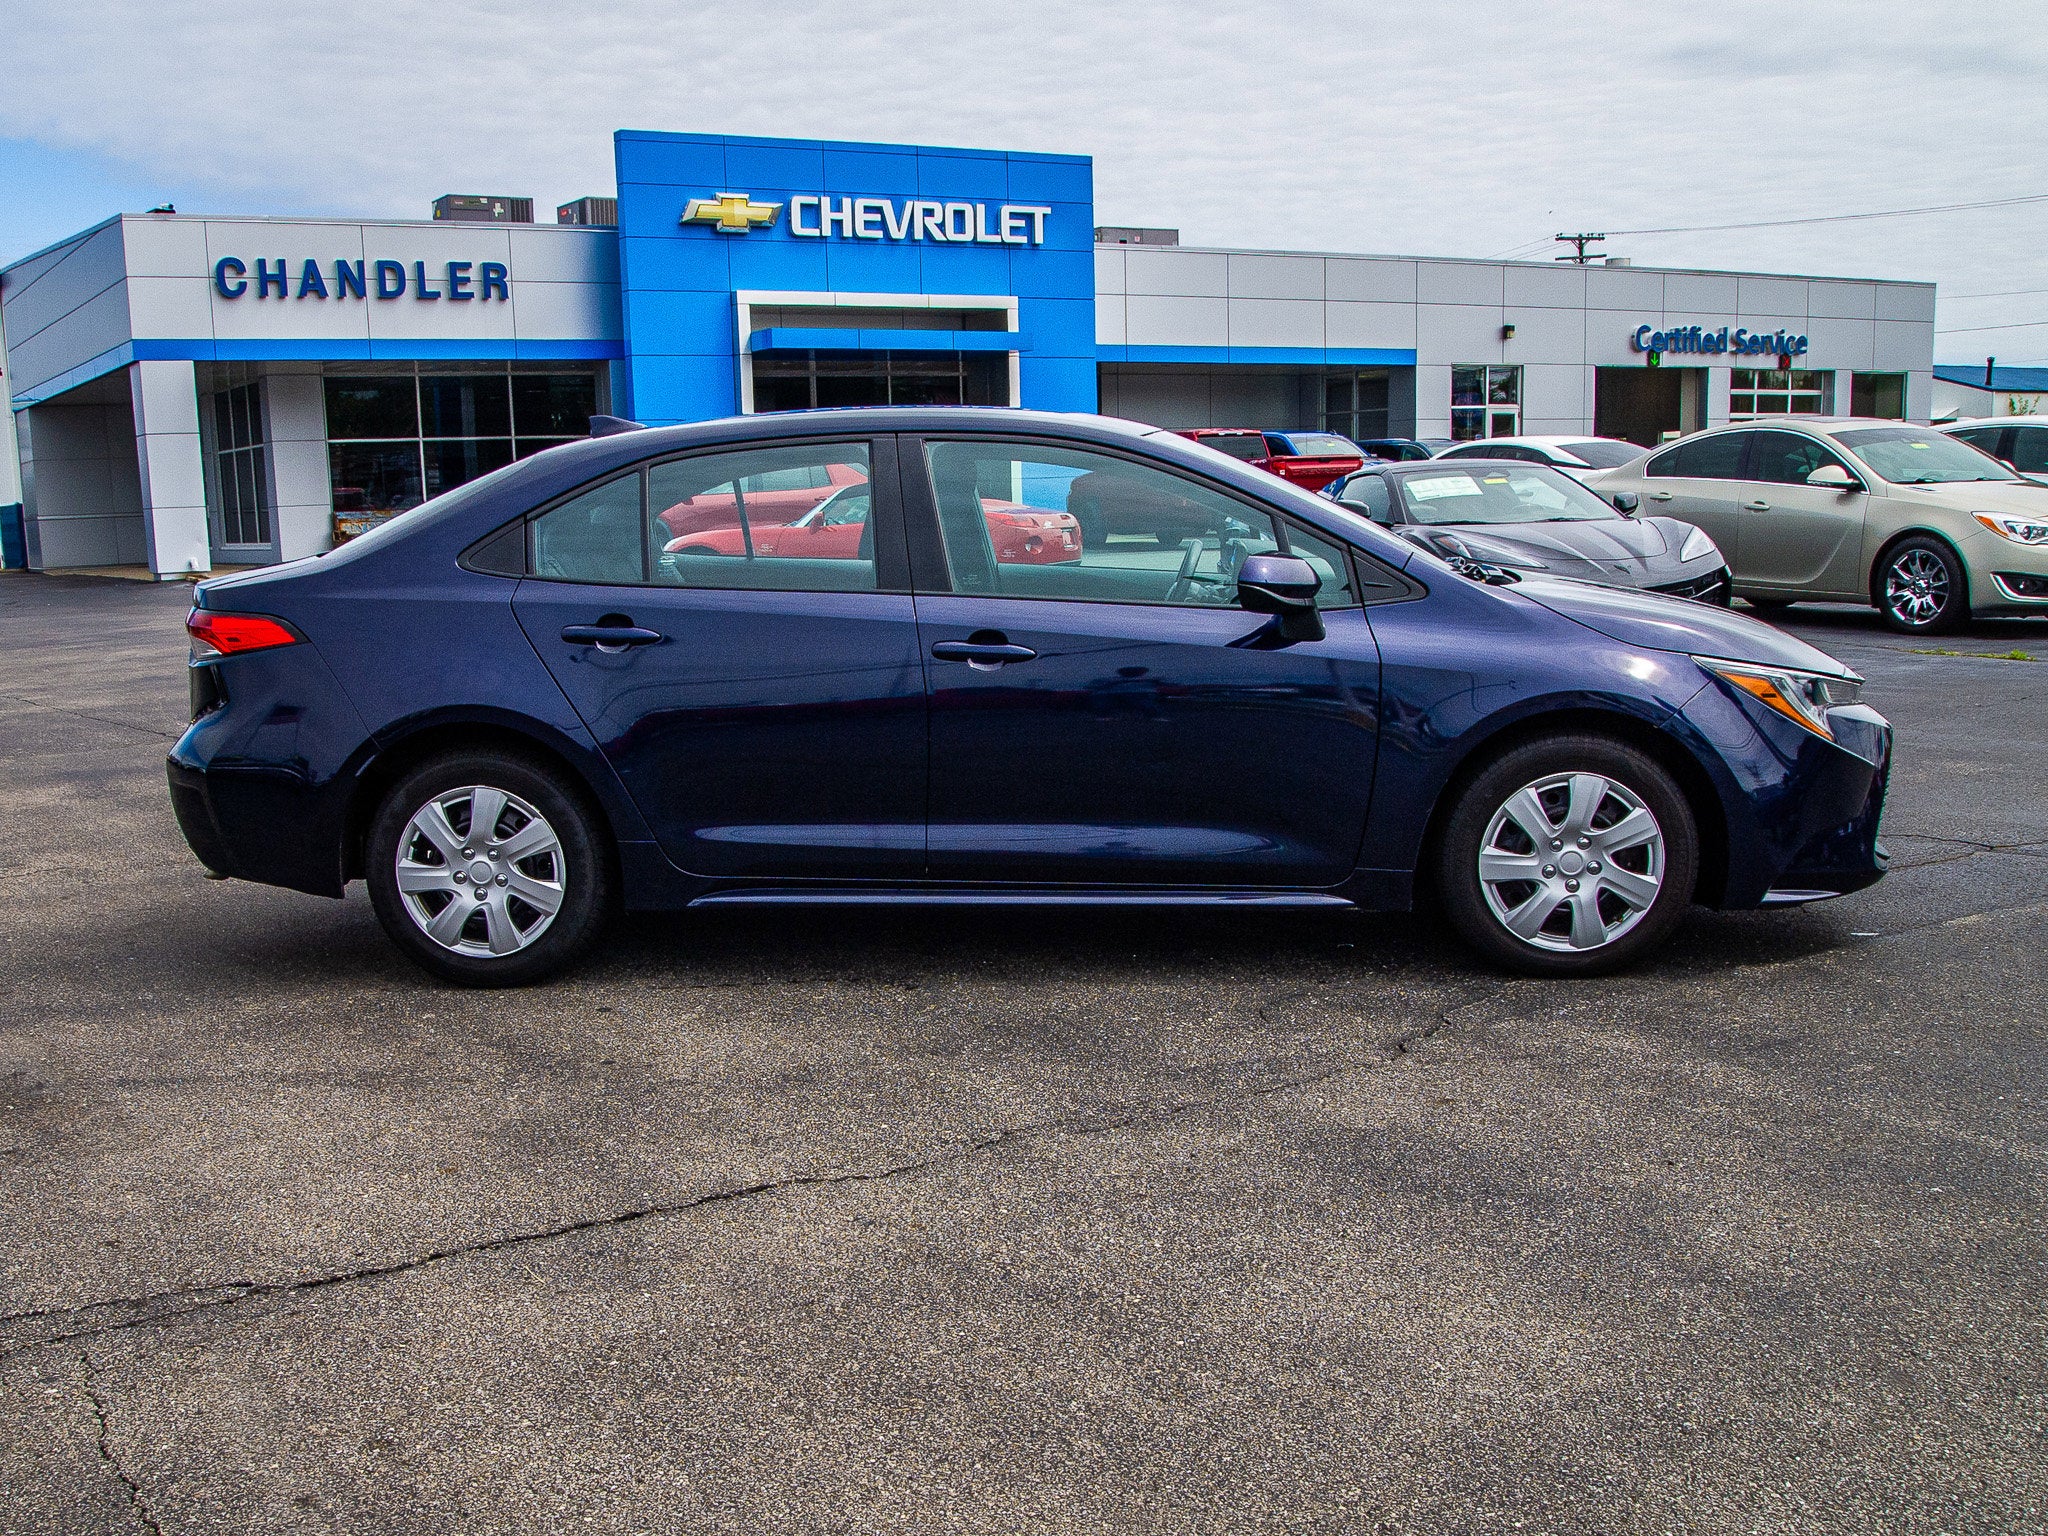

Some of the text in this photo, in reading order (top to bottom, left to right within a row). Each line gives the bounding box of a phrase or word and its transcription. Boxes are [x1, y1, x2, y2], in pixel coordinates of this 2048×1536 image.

[790, 195, 1051, 244] CHEVROLET
[214, 256, 510, 299] CHANDLER
[1634, 324, 1808, 355] Certified Service
